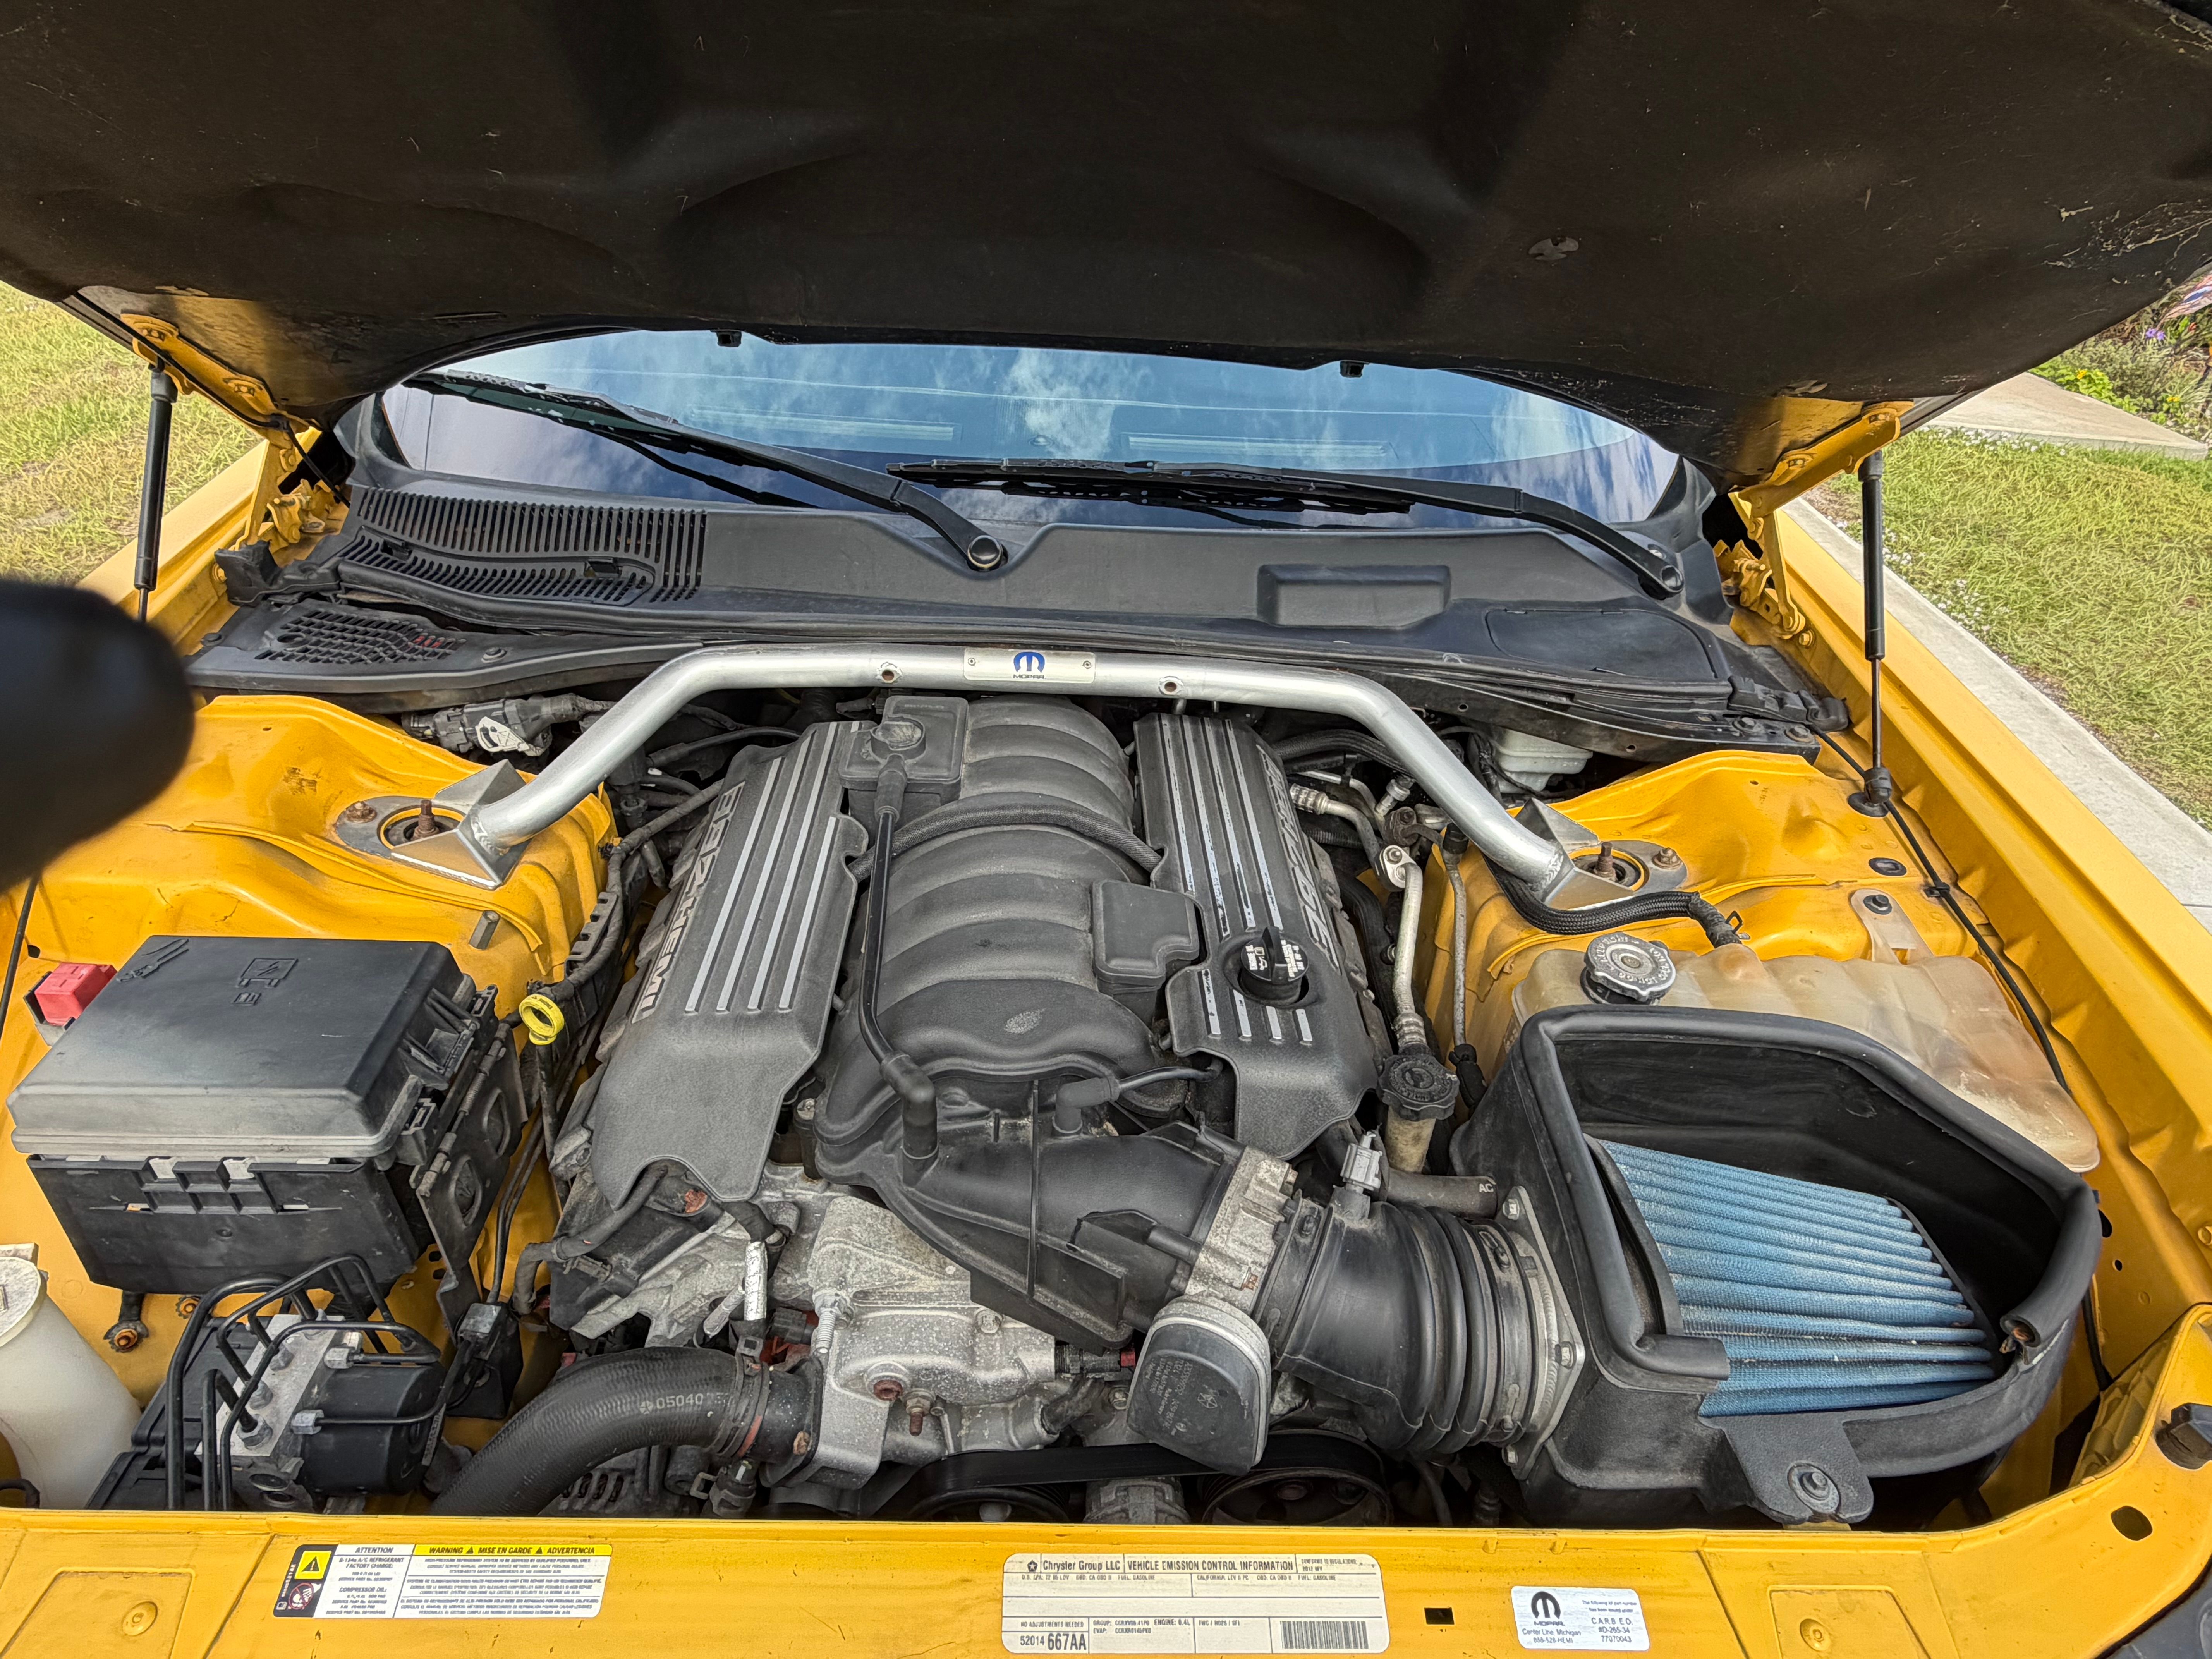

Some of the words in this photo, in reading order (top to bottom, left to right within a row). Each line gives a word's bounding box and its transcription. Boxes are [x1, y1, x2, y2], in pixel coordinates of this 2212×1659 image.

[686, 783, 744, 896] 392
[641, 895, 697, 1012] HEMI
[1479, 1183, 1494, 1192] AC
[1043, 1560, 1076, 1572] Chrysler
[1078, 1560, 1103, 1572] Group
[1105, 1560, 1120, 1570] LLC
[1127, 1560, 1159, 1570] VEHICLE
[1162, 1560, 1199, 1570] EMISSION
[1202, 1560, 1238, 1571] CONTROL
[1240, 1561, 1293, 1571] INFORMATION
[1020, 1635, 1044, 1645] 52014
[1048, 1633, 1087, 1650] 667AA
